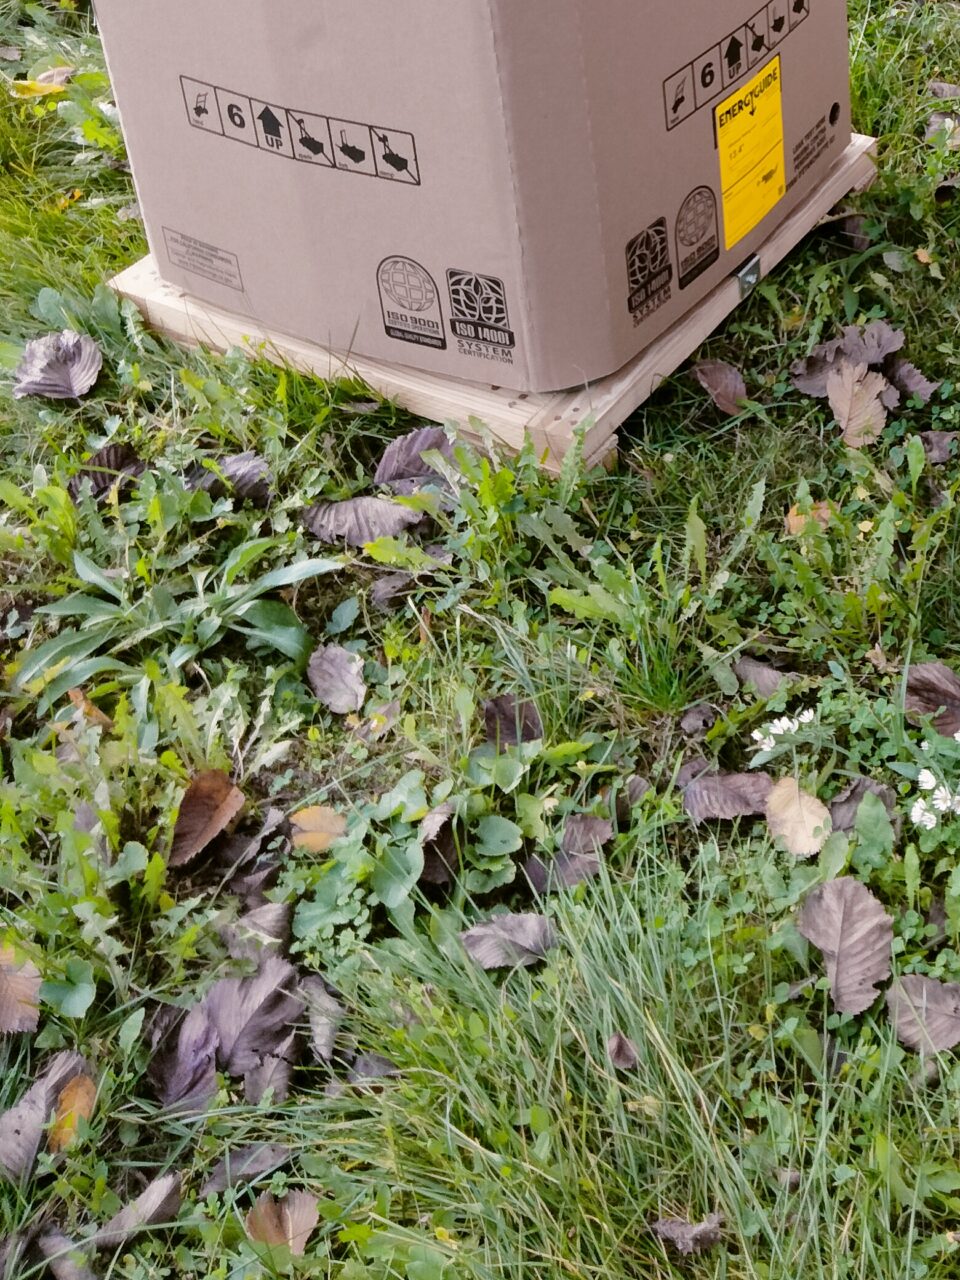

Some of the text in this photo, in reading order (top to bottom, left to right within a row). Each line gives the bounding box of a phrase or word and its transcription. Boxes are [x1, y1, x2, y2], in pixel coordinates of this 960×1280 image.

[700, 61, 715, 89] 6
[728, 61, 742, 80] UP
[227, 103, 245, 129] 6
[265, 134, 283, 150] UP
[386, 310, 439, 330] ISO 9001
[455, 321, 476, 338] ISO
[477, 325, 510, 346] 14001
[457, 339, 513, 358] SYSTEM
[458, 347, 514, 365] CERTIFICATION
